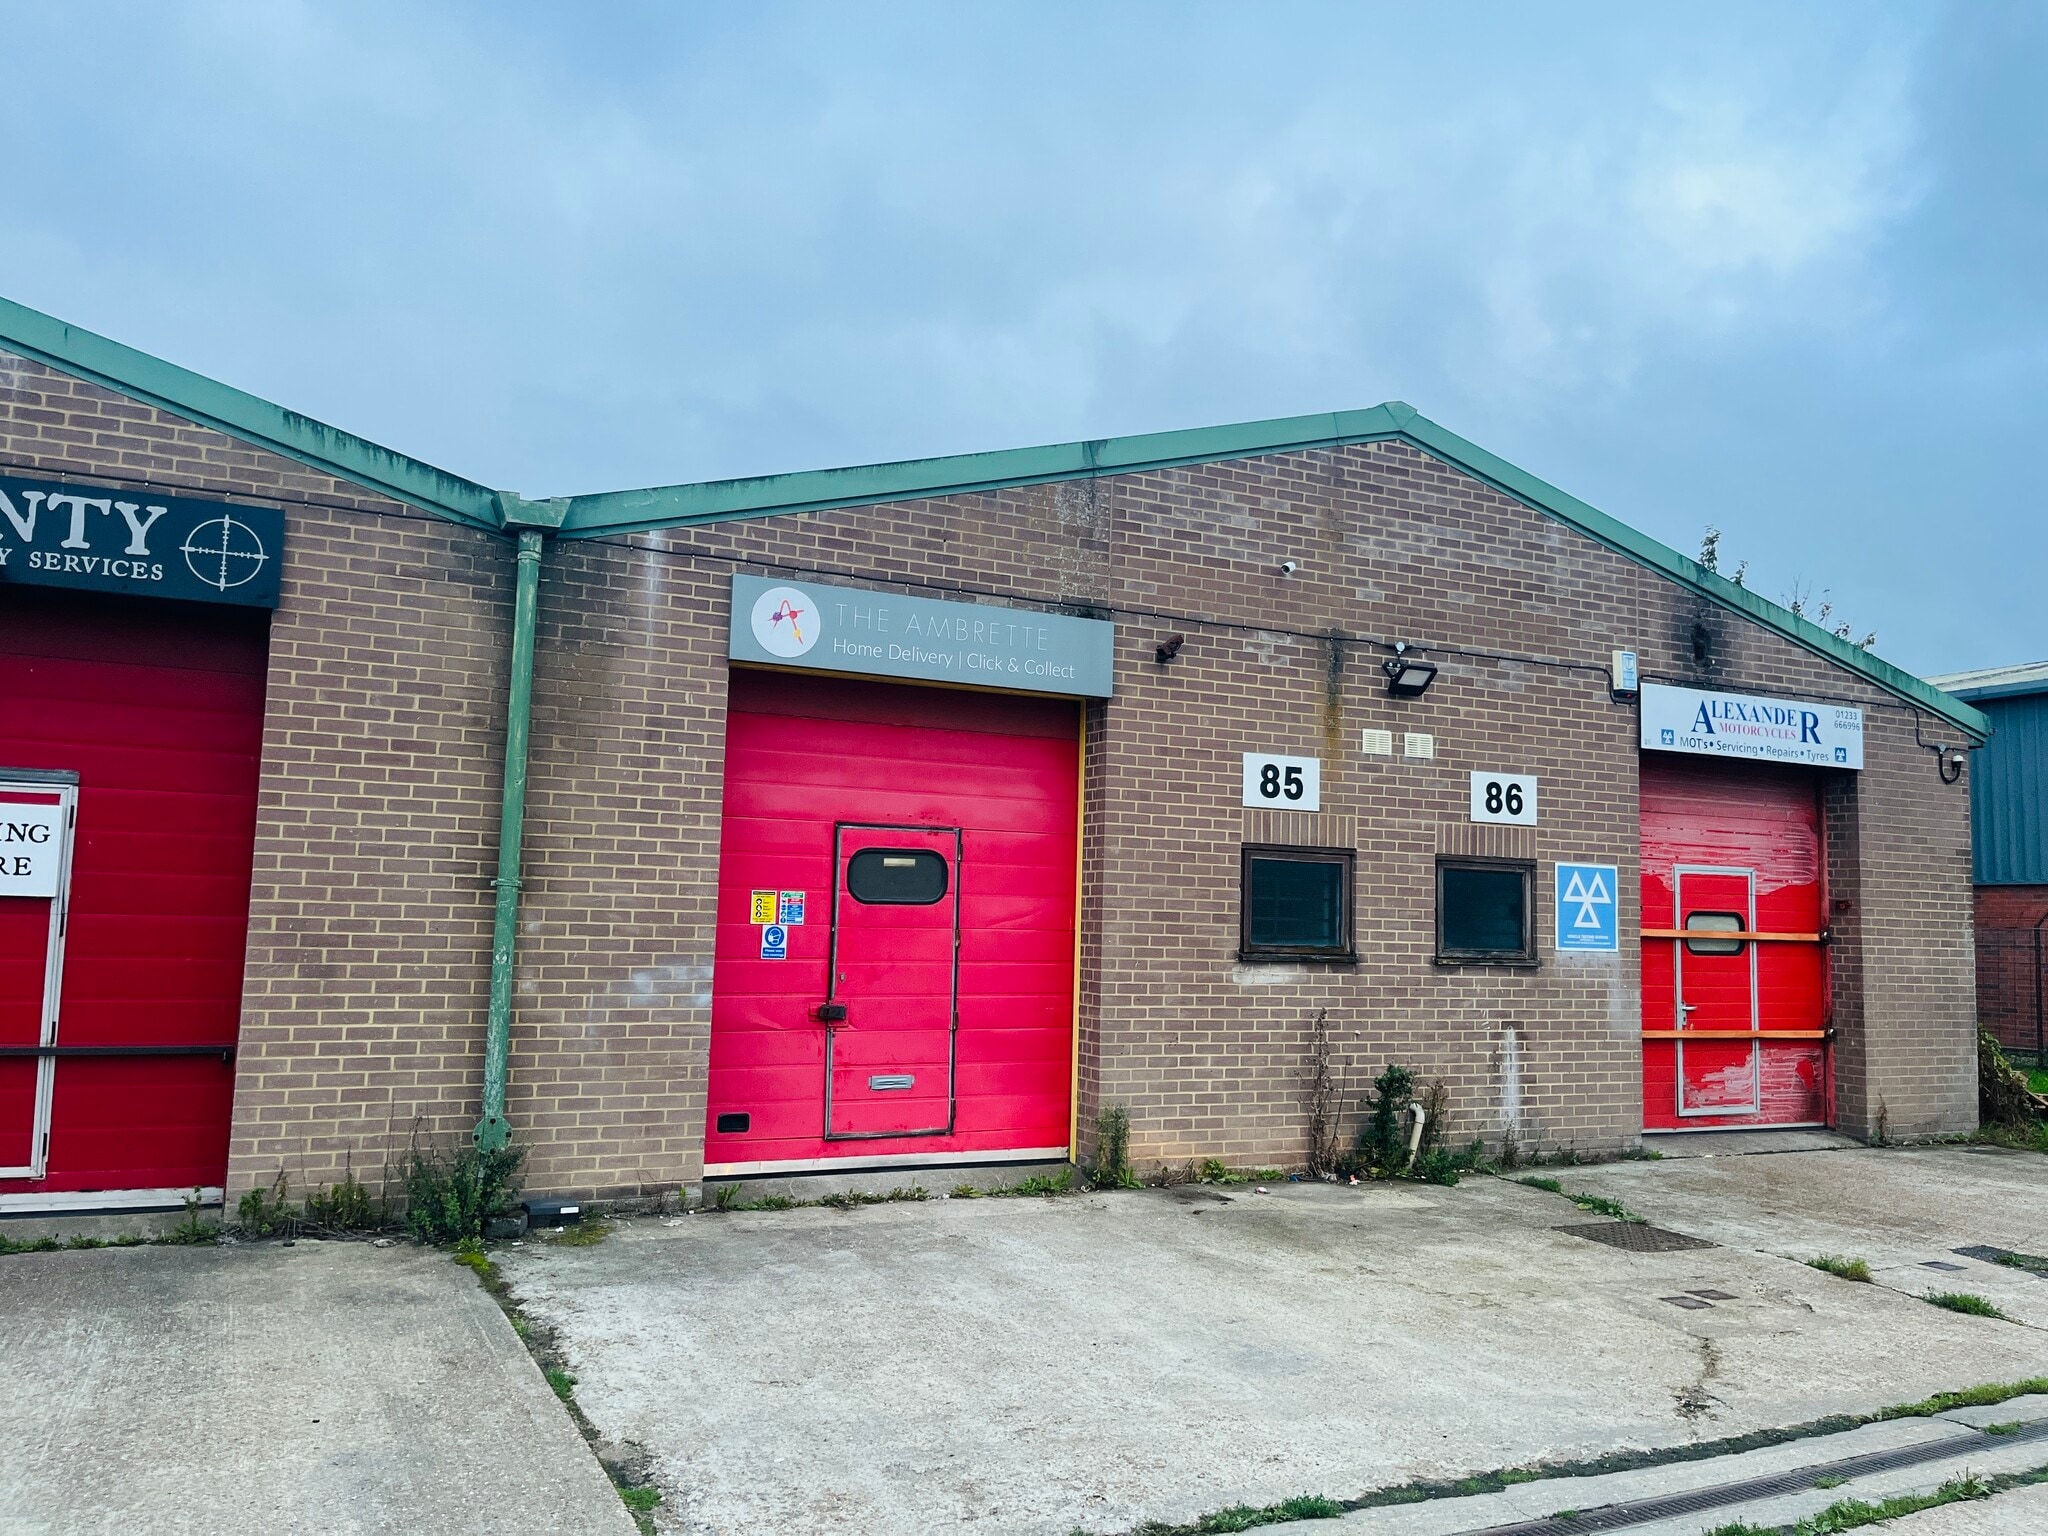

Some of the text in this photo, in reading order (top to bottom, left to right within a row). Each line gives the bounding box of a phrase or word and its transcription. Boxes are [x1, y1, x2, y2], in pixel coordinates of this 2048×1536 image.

[29, 551, 163, 581] SERVICES
[835, 603, 1048, 651] THE AMBRETTE
[833, 637, 882, 658] Home
[888, 643, 953, 669] Delivery
[966, 652, 1003, 672] Click
[1007, 657, 1019, 673] &
[1024, 659, 1075, 679] Collect
[1690, 699, 1822, 745] ALEXANDER
[1833, 720, 1861, 732] 666996
[1835, 710, 1858, 721] 01233
[1719, 722, 1797, 740] MOTORCYCLES
[1716, 740, 1758, 757] Servicing
[1766, 745, 1799, 759] Repairs
[1807, 749, 1829, 762] Tyres
[1259, 763, 1304, 801] 85
[1485, 781, 1523, 816] 86
[0, 822, 51, 844] NG
